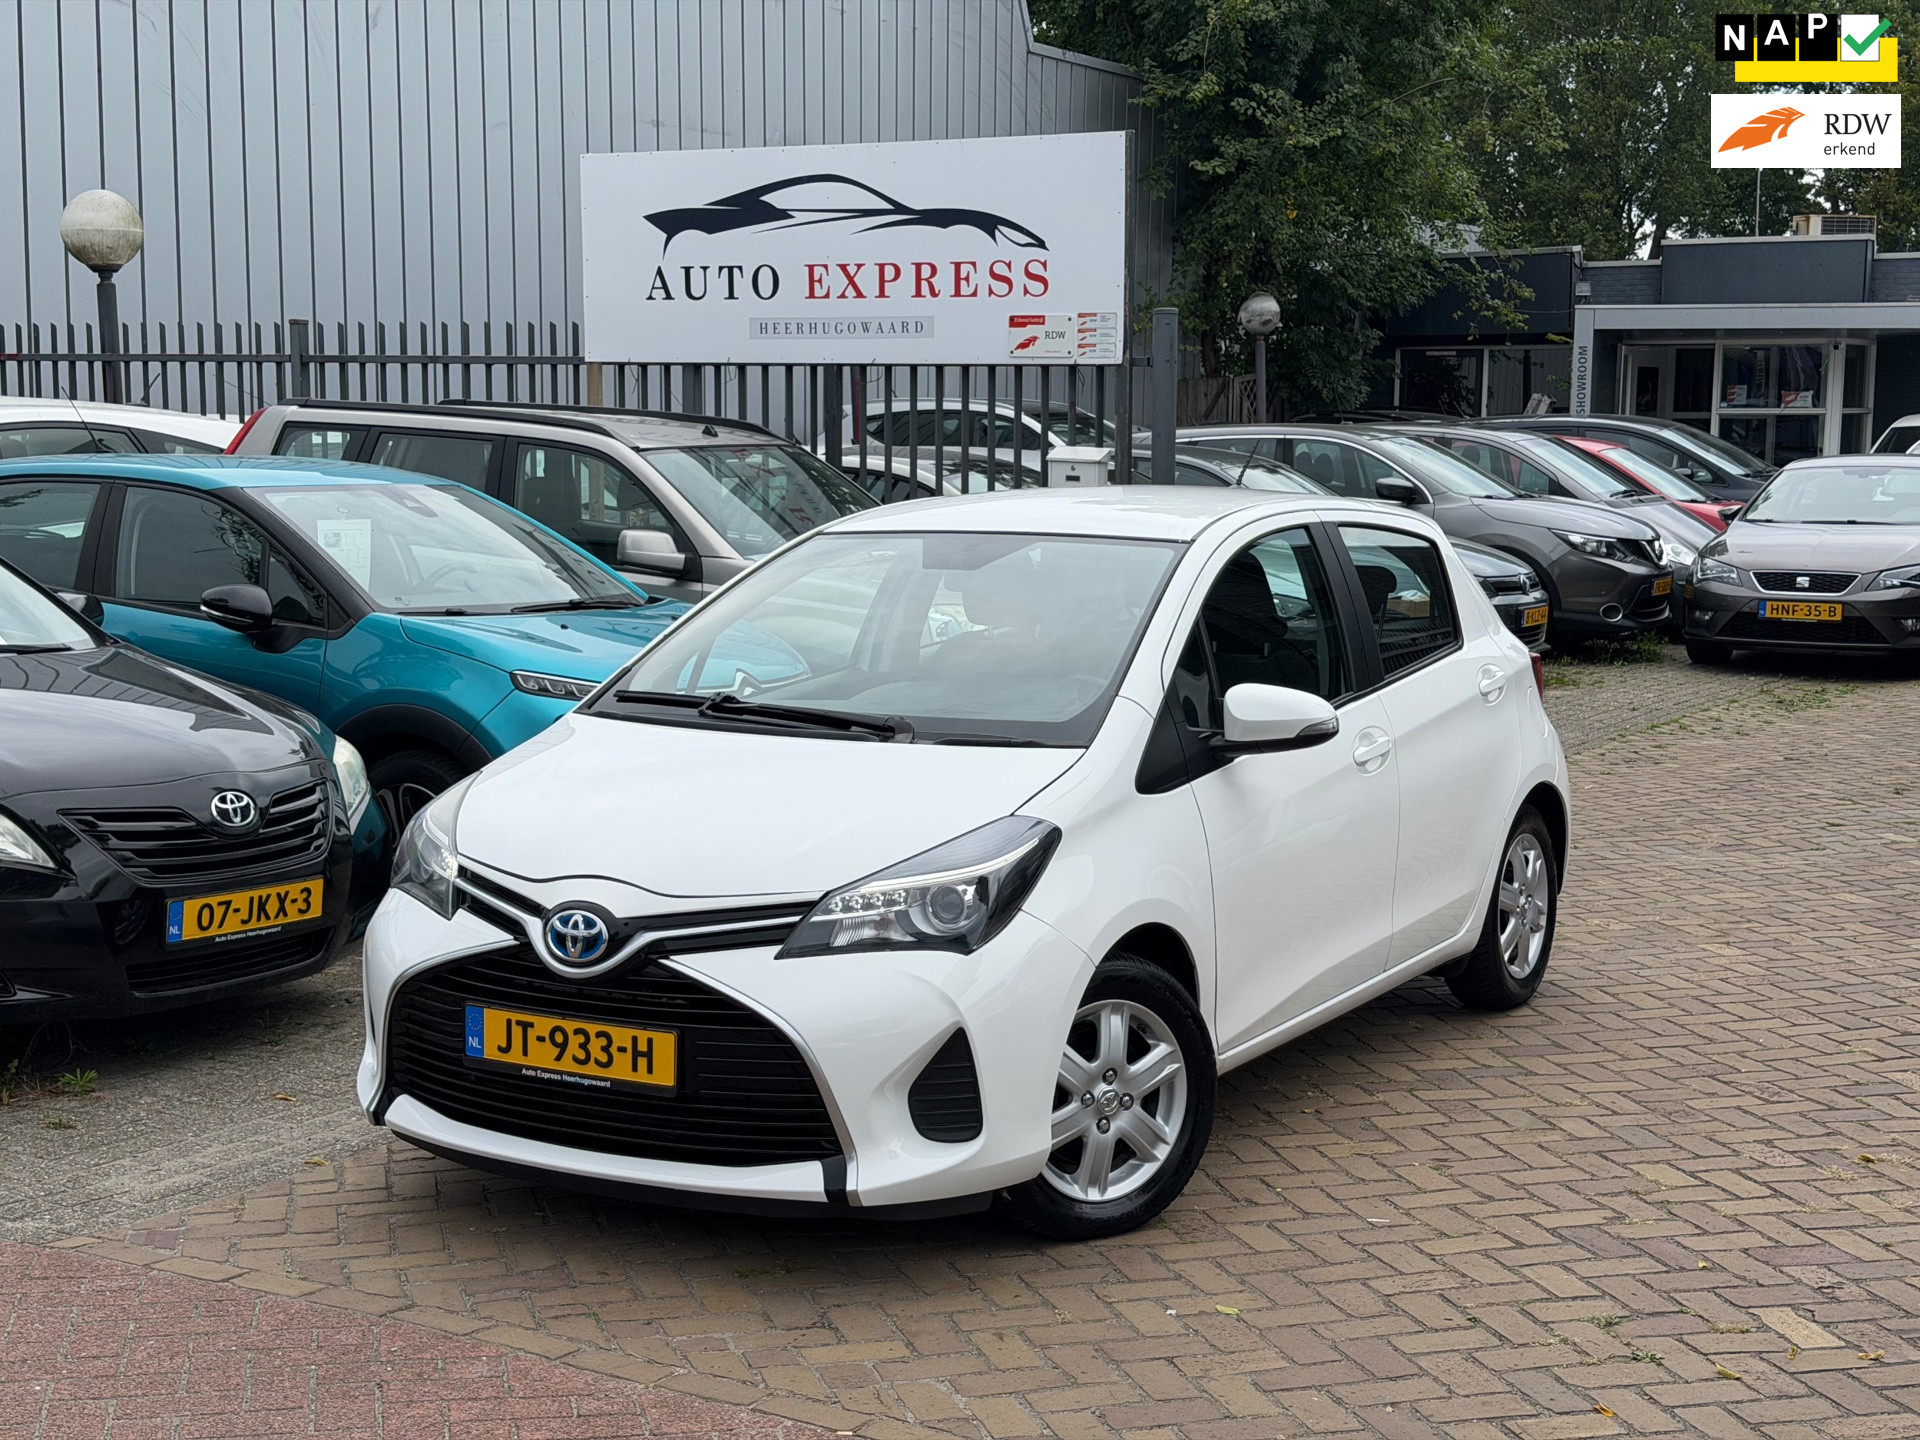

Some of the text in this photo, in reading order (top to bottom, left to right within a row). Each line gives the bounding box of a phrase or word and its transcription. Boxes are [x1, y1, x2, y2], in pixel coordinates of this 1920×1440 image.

[645, 258, 1050, 301] AUTO EXPRESS
[759, 320, 925, 335] HEERHUGOWAARD
[1044, 330, 1067, 340] RDW
[1575, 345, 1588, 415] SHOWROOM
[1770, 603, 1837, 617] HNF-35-B
[197, 886, 312, 932] 07-JKX-3
[169, 925, 181, 935] NL
[214, 925, 282, 943] Auto Express Heerhugowaard
[468, 1035, 482, 1049] NL
[496, 1017, 654, 1075] JT-933-H
[521, 1067, 611, 1088] Auto Express Heerhugowaard
